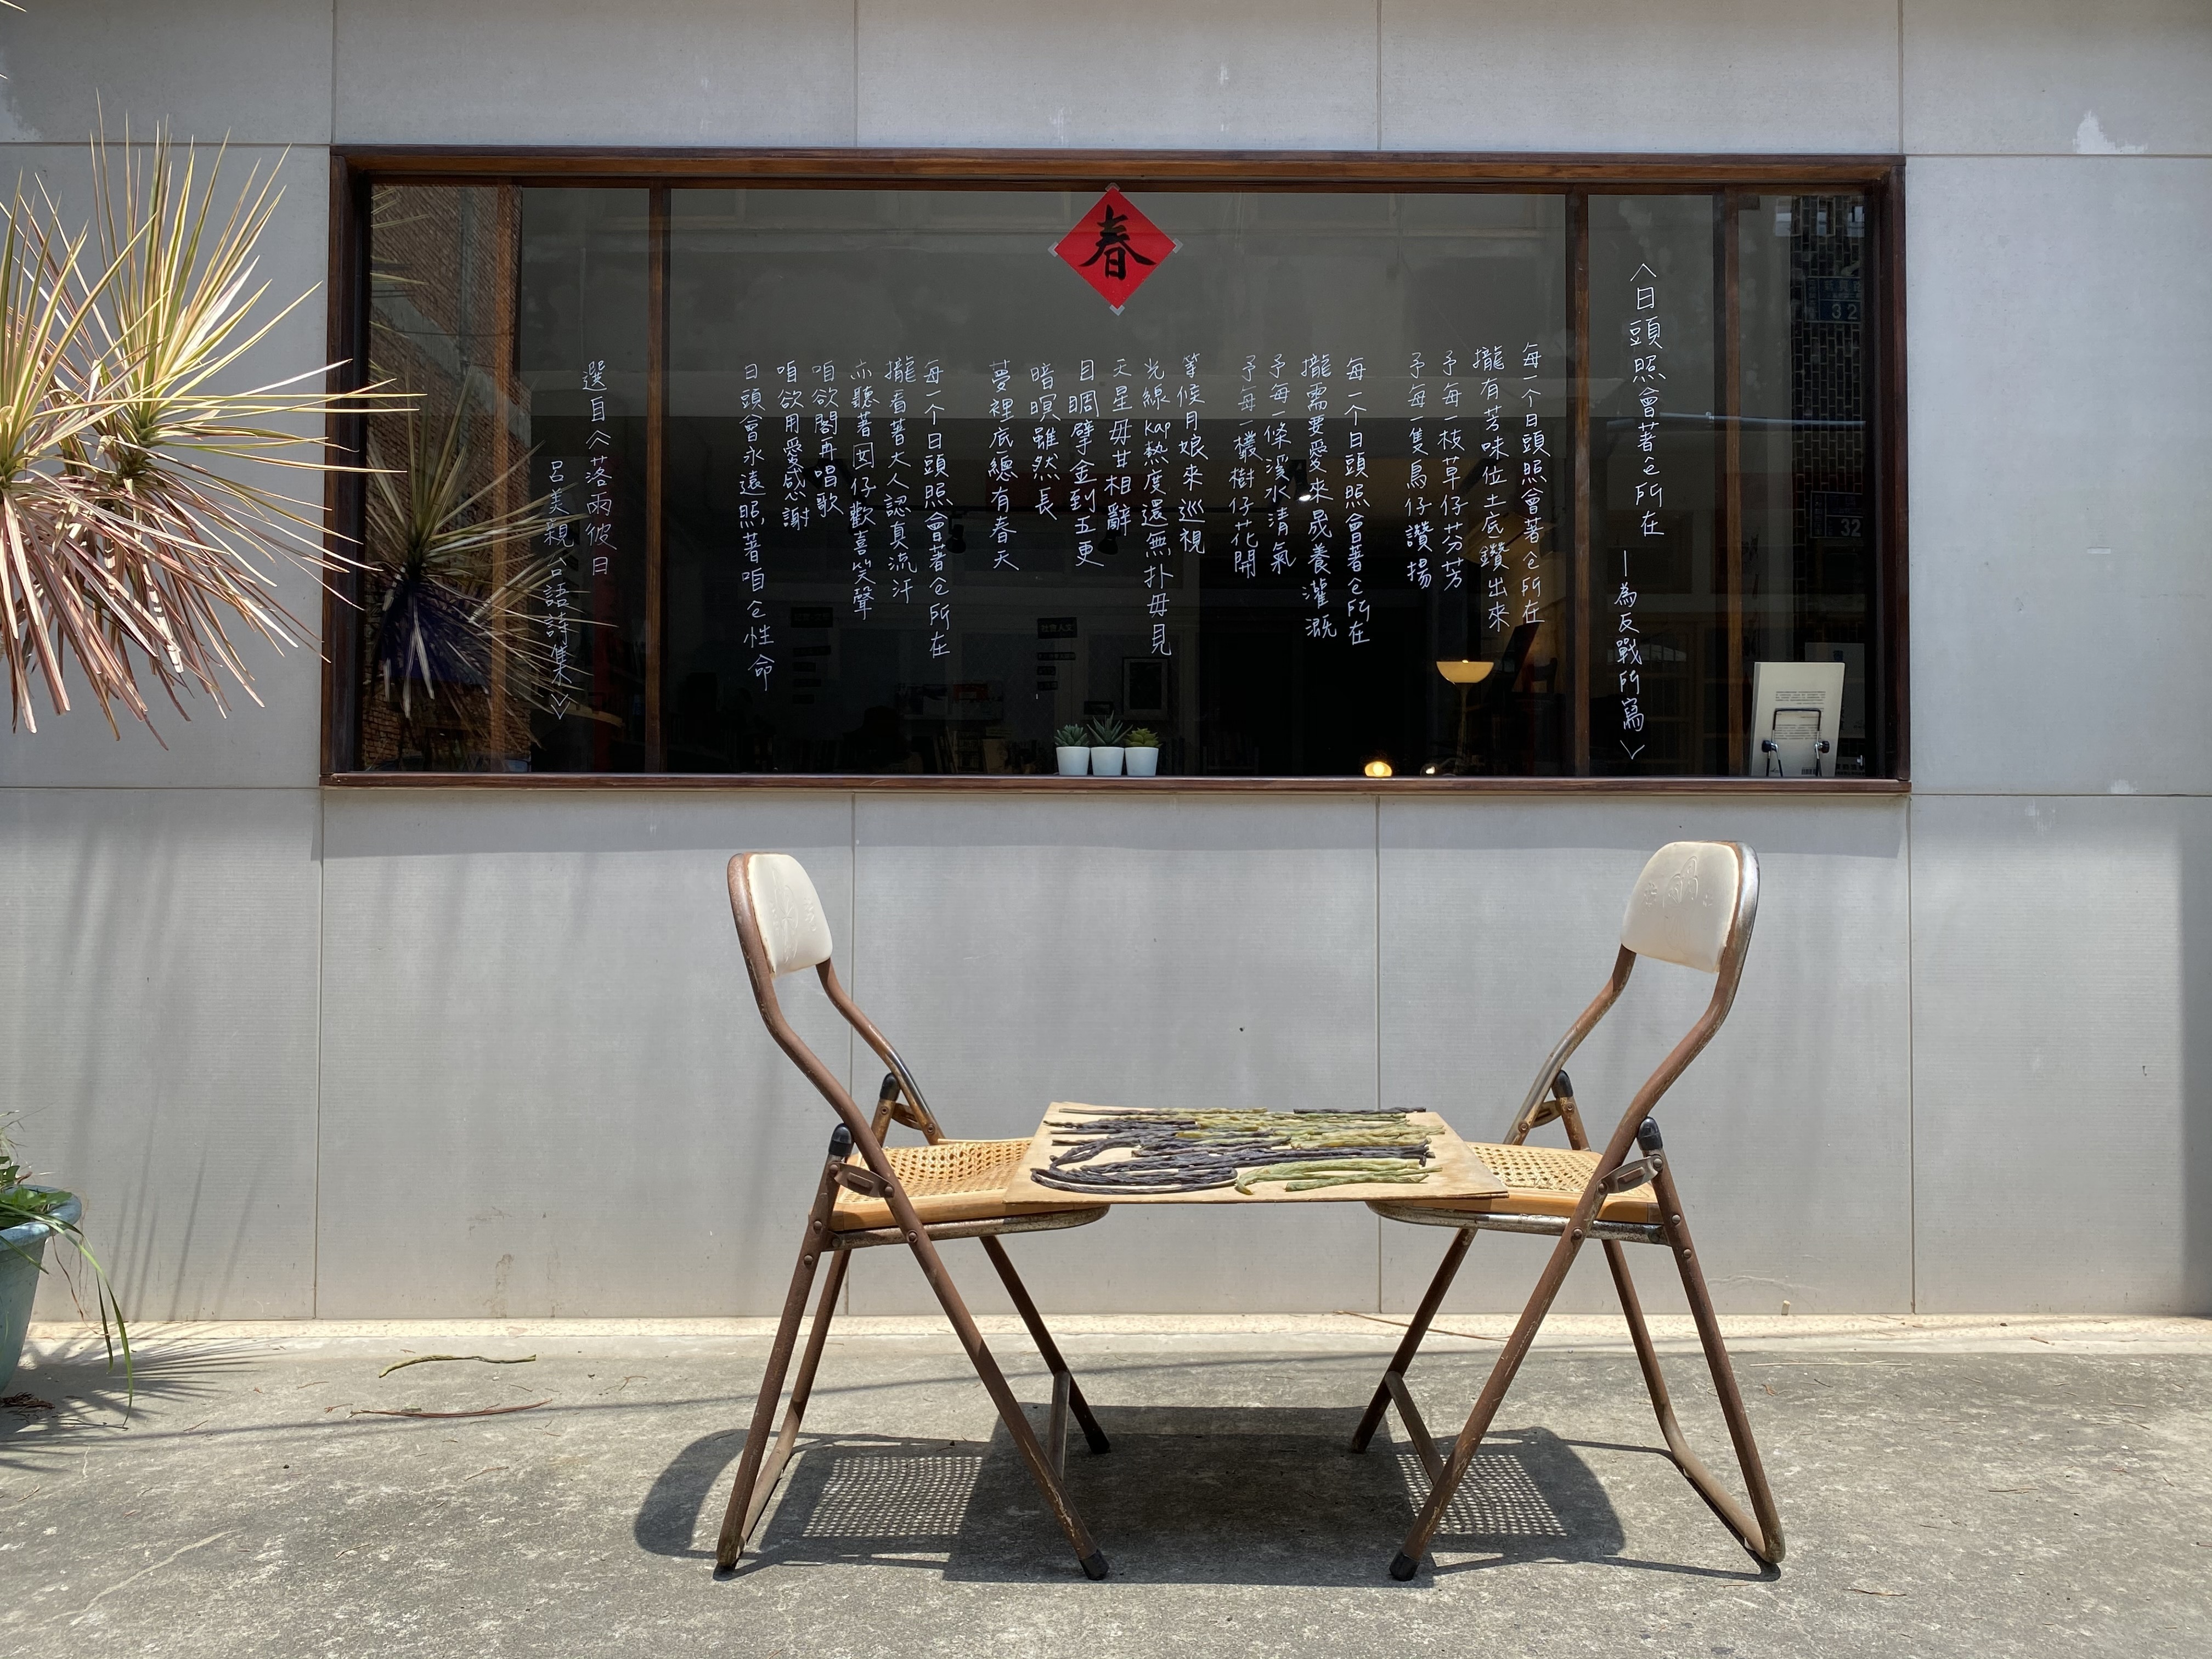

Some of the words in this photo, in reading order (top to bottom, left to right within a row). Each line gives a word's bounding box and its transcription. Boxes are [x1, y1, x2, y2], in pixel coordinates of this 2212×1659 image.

[1078, 204, 1157, 281] 春
[1831, 302, 1858, 320] 32
[777, 360, 810, 531] 咱欲用愛感謝
[811, 360, 844, 518] 咱欲閣再唱歌
[884, 356, 918, 604] 攏看著大人認真流汗
[1177, 353, 1209, 555] 等候月娘來巡視
[1404, 352, 1434, 590] 予每一隻鳥仔讚揚
[1437, 349, 1469, 591] 予每一枝草仔芬芳
[1840, 517, 1861, 537] 32
[1040, 624, 1074, 633] 社會人文
